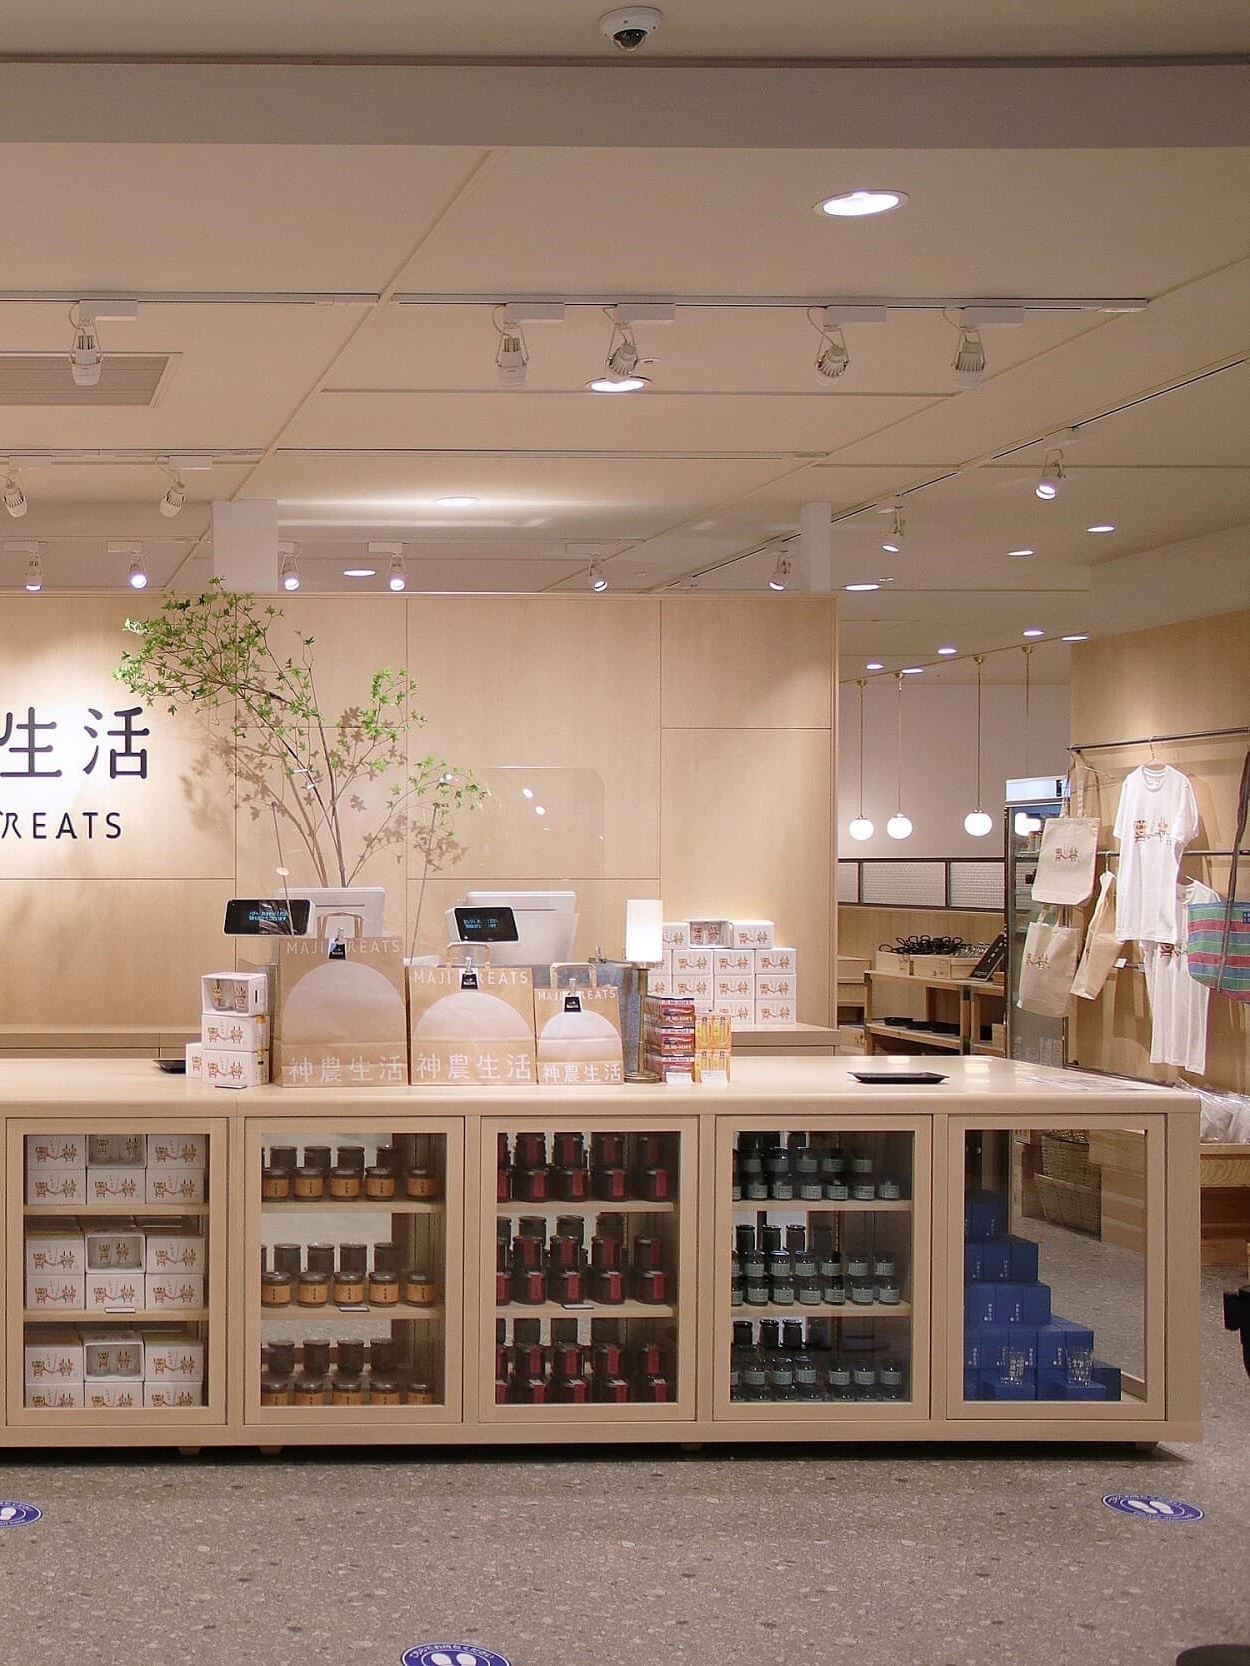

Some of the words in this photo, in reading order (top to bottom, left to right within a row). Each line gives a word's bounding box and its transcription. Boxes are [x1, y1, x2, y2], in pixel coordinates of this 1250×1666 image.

[286, 941, 325, 954] MAJI
[344, 940, 400, 953] REATS
[413, 970, 451, 985] MAJI
[476, 970, 529, 985] REATS
[579, 989, 616, 1000] REATS
[288, 1056, 402, 1083] 神農生活
[416, 1053, 532, 1080] 神農生活
[541, 1062, 622, 1084] 神農生活
